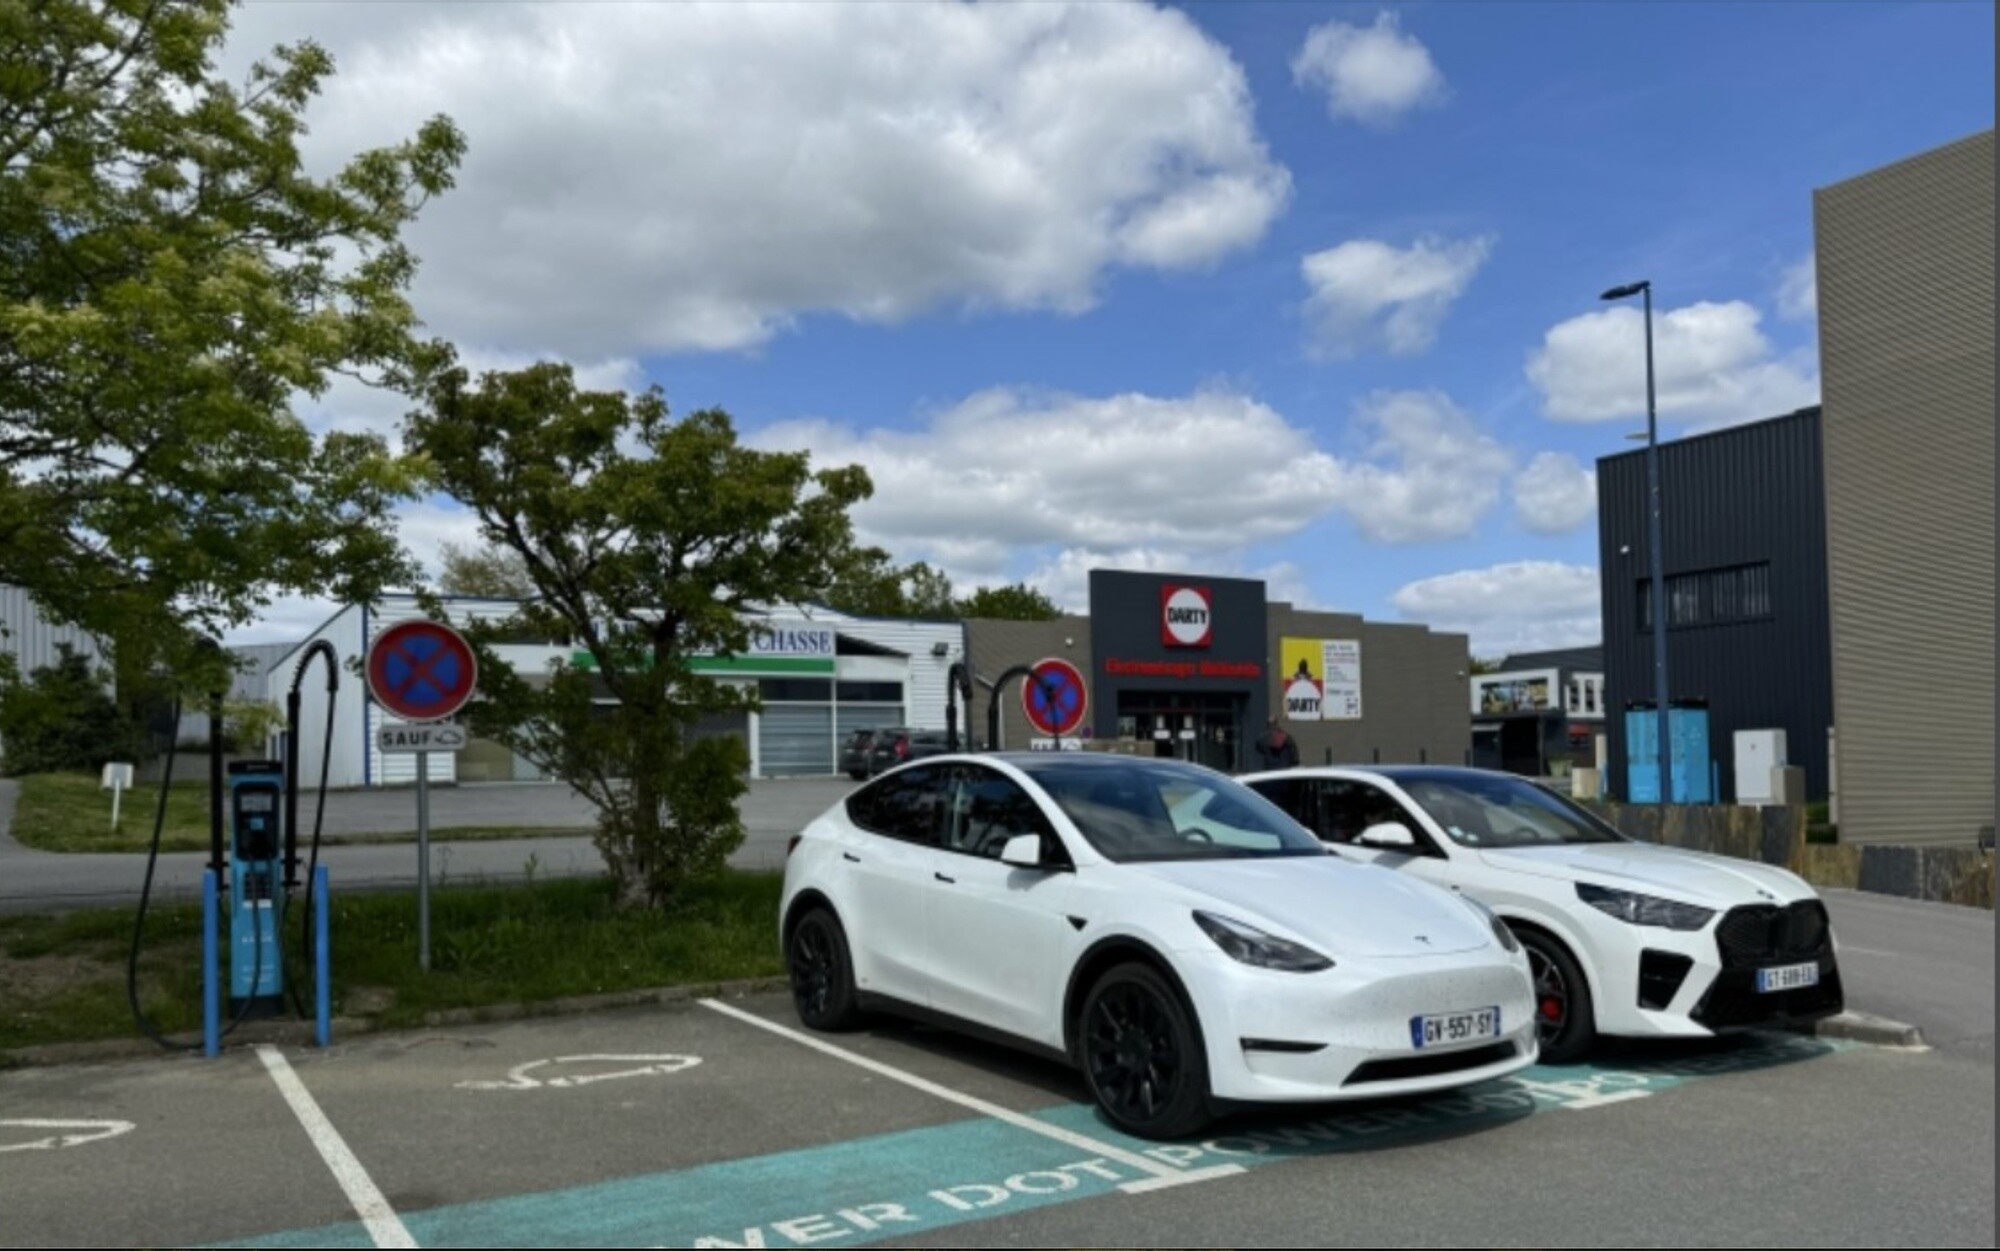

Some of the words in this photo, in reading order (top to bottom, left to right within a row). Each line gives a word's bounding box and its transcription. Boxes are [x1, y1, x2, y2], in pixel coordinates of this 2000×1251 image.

[1168, 607, 1206, 624] DARTY
[754, 629, 831, 653] CHASSE
[1289, 698, 1320, 712] DARTY
[382, 730, 431, 746] SAUF
[928, 1158, 1123, 1210] DOT
